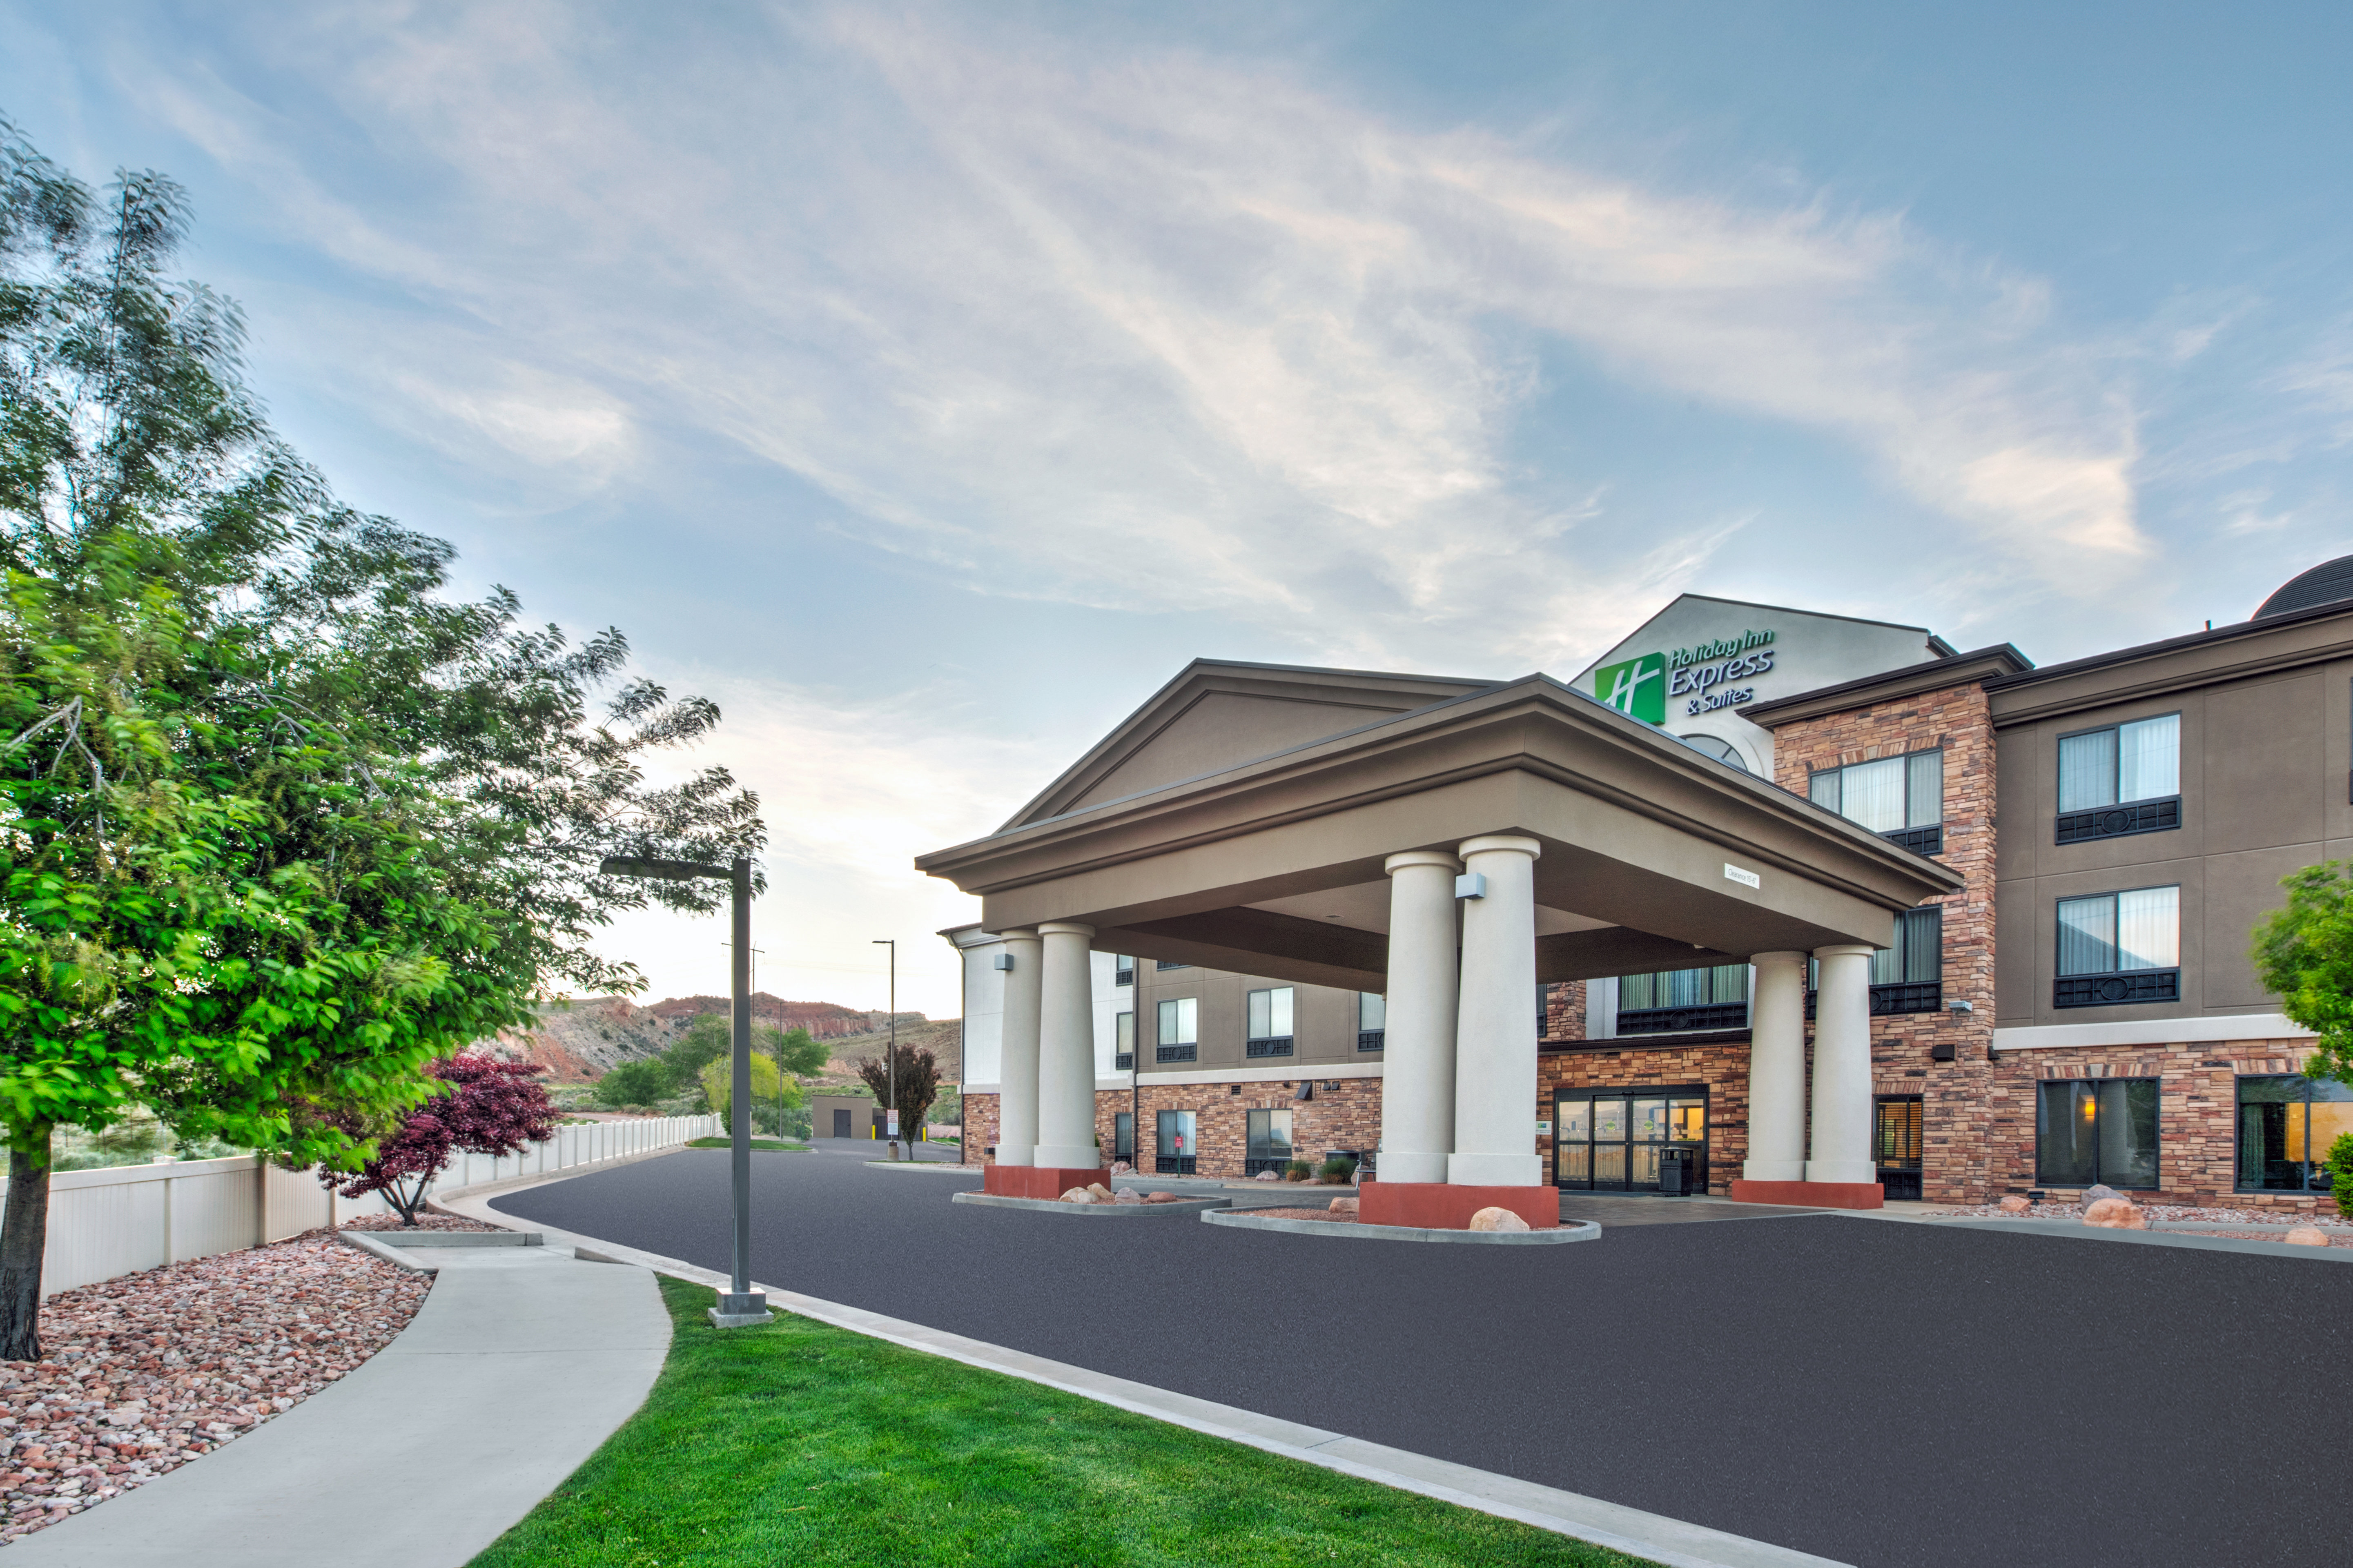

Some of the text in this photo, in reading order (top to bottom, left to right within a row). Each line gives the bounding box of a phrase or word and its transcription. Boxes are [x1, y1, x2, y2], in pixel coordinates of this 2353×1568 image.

[1669, 629, 1774, 669] Holiday Inn
[1669, 650, 1774, 696] Express
[1686, 687, 1753, 716] & Suites
[1728, 869, 1746, 881] Clearance
